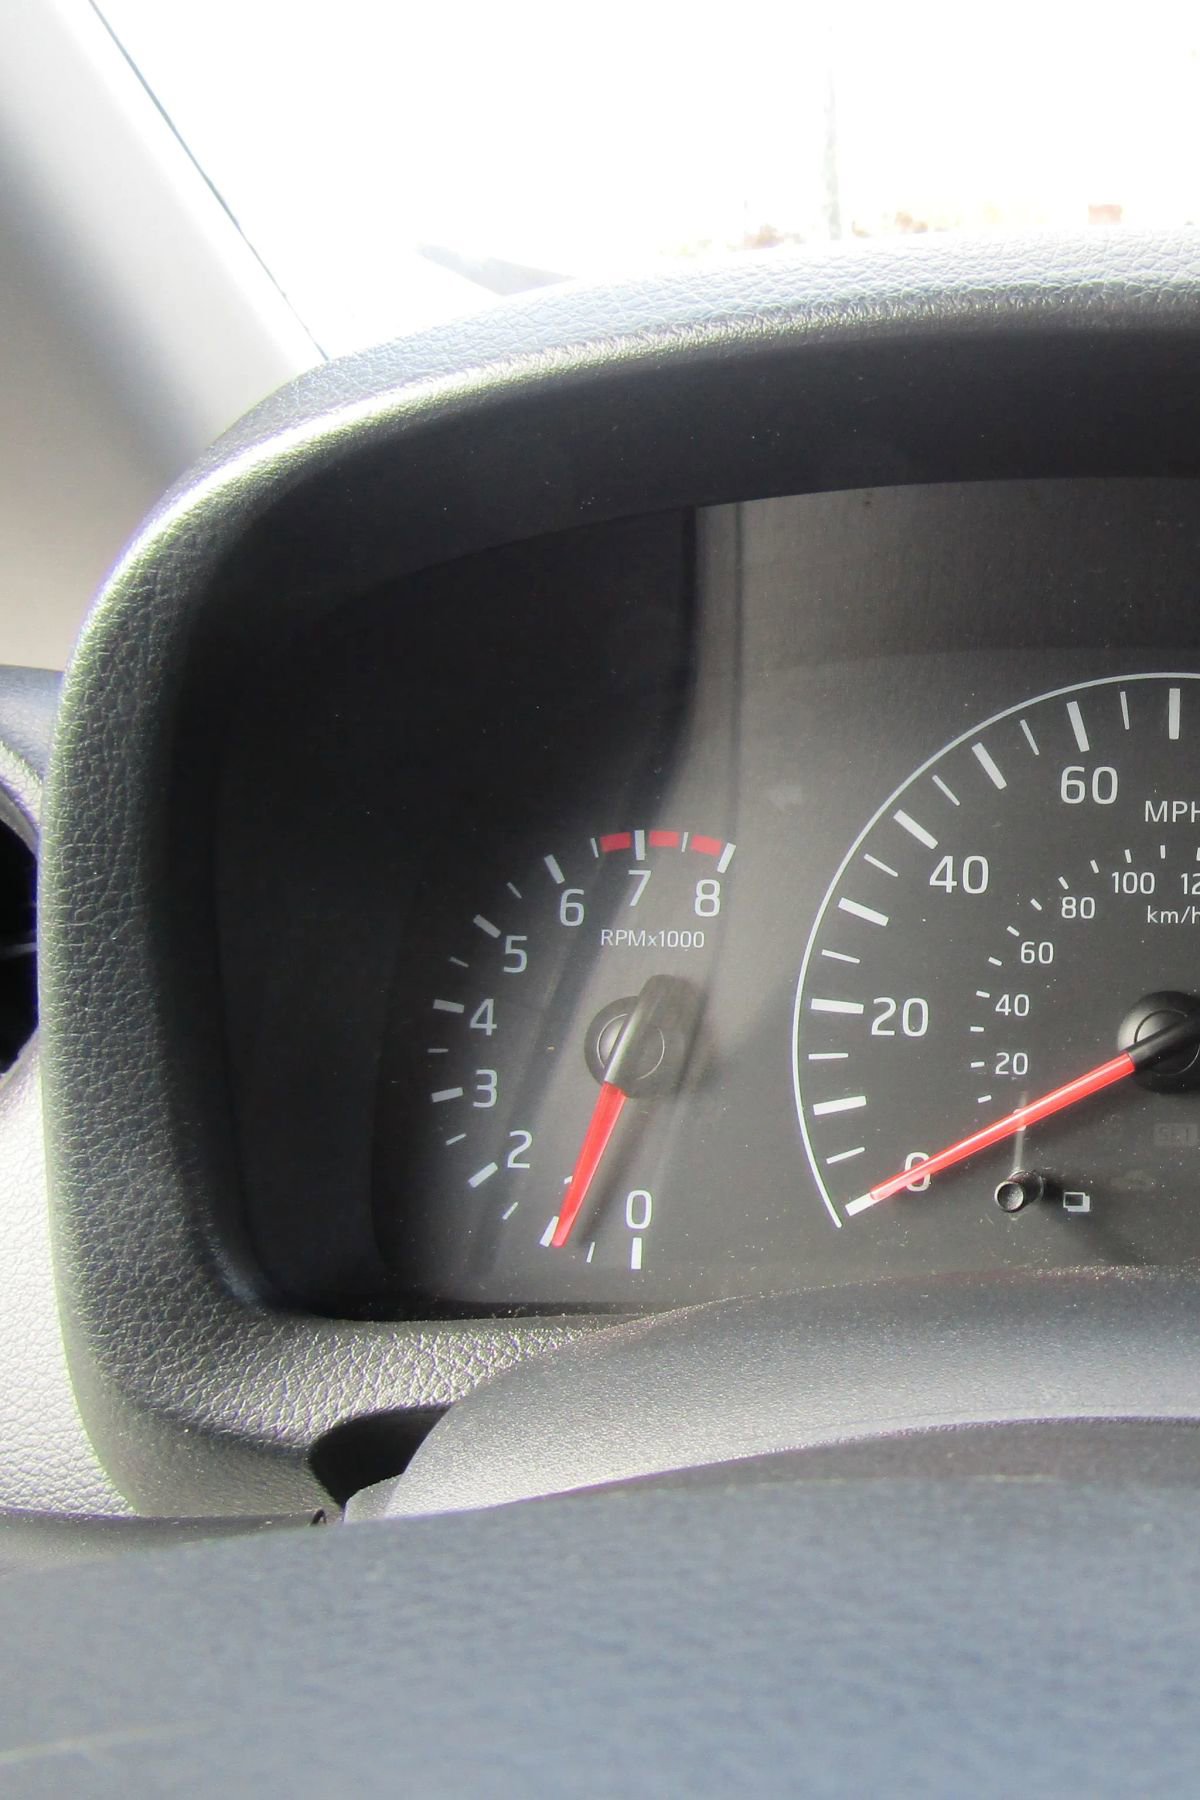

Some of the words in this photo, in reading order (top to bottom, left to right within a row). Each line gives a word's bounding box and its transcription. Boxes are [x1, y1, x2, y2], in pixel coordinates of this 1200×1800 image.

[1060, 766, 1119, 805] 60
[628, 870, 651, 906] 7
[929, 855, 990, 894] 40
[1111, 872, 1156, 895] 100
[560, 889, 584, 926] 6
[695, 879, 721, 917] 8
[1061, 897, 1095, 920] 80
[503, 935, 528, 973] 5
[600, 929, 705, 949] RPMx1000
[1020, 941, 1054, 965] 60
[470, 998, 497, 1036] 4
[871, 997, 929, 1037] 20
[995, 994, 1030, 1017] 40
[994, 1053, 1029, 1075] 20
[473, 1069, 497, 1108] 3
[507, 1130, 530, 1169] 2
[903, 1152, 932, 1192] 0
[626, 1190, 652, 1229] 0
